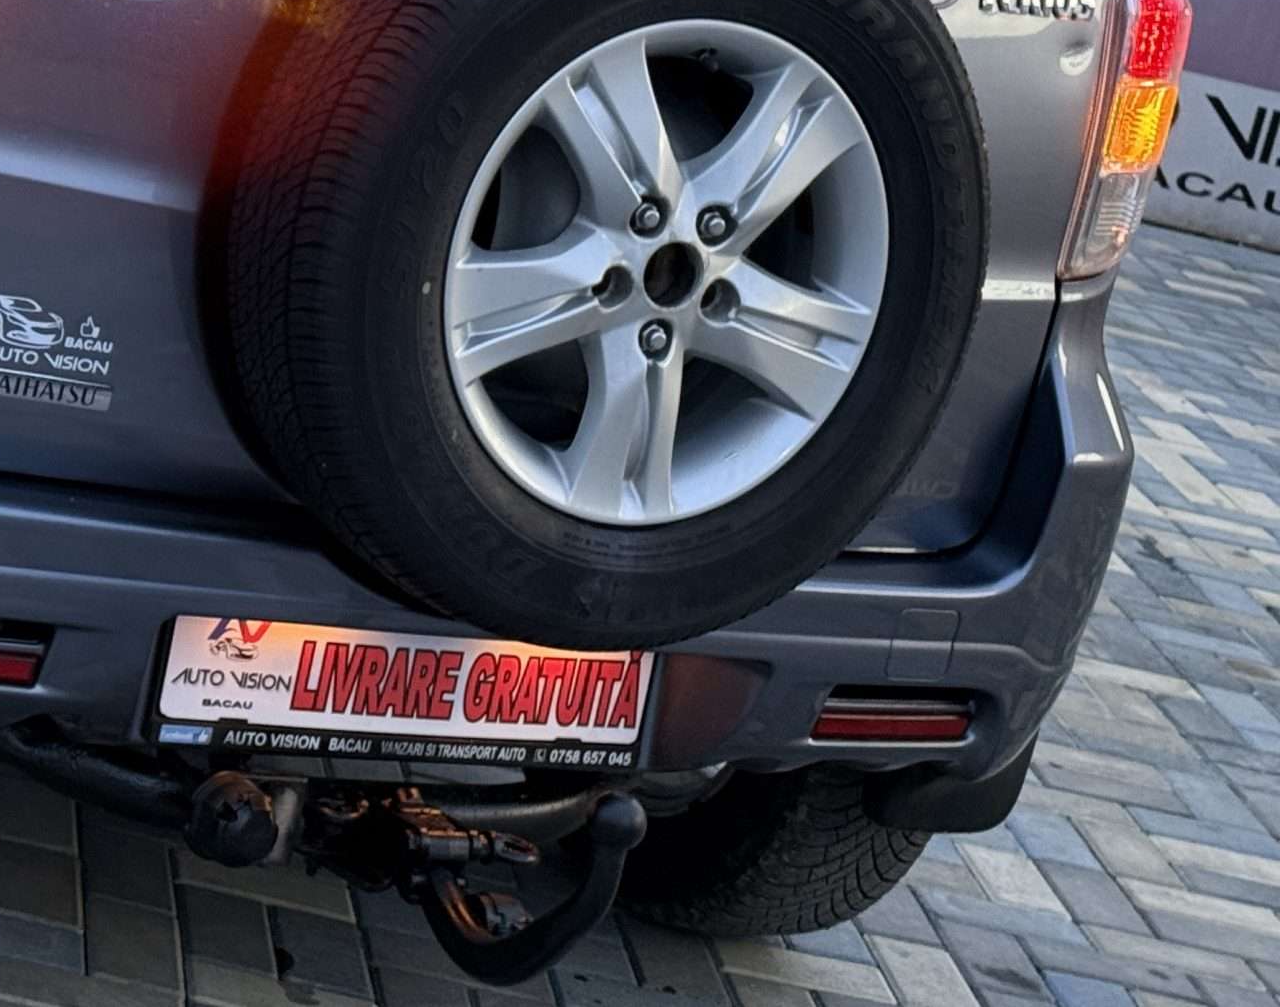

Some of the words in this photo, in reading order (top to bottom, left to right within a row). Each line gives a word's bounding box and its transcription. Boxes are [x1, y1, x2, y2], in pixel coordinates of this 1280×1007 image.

[1206, 93, 1280, 167] VI
[64, 336, 114, 354] BACAU
[44, 352, 110, 375] VISION
[172, 668, 224, 686] AUTO
[230, 670, 292, 692] VISION
[290, 640, 464, 720] LIVRARE
[202, 698, 253, 710] BACAU
[224, 729, 267, 747] AUTO
[271, 732, 321, 751] VISION
[328, 736, 372, 753] BACAU
[381, 740, 424, 756] VANZARI
[437, 744, 499, 760] TRANSPORT
[498, 746, 527, 762] AUTO
[549, 749, 580, 765] 0758
[582, 750, 606, 765] 657
[608, 751, 632, 766] 045
